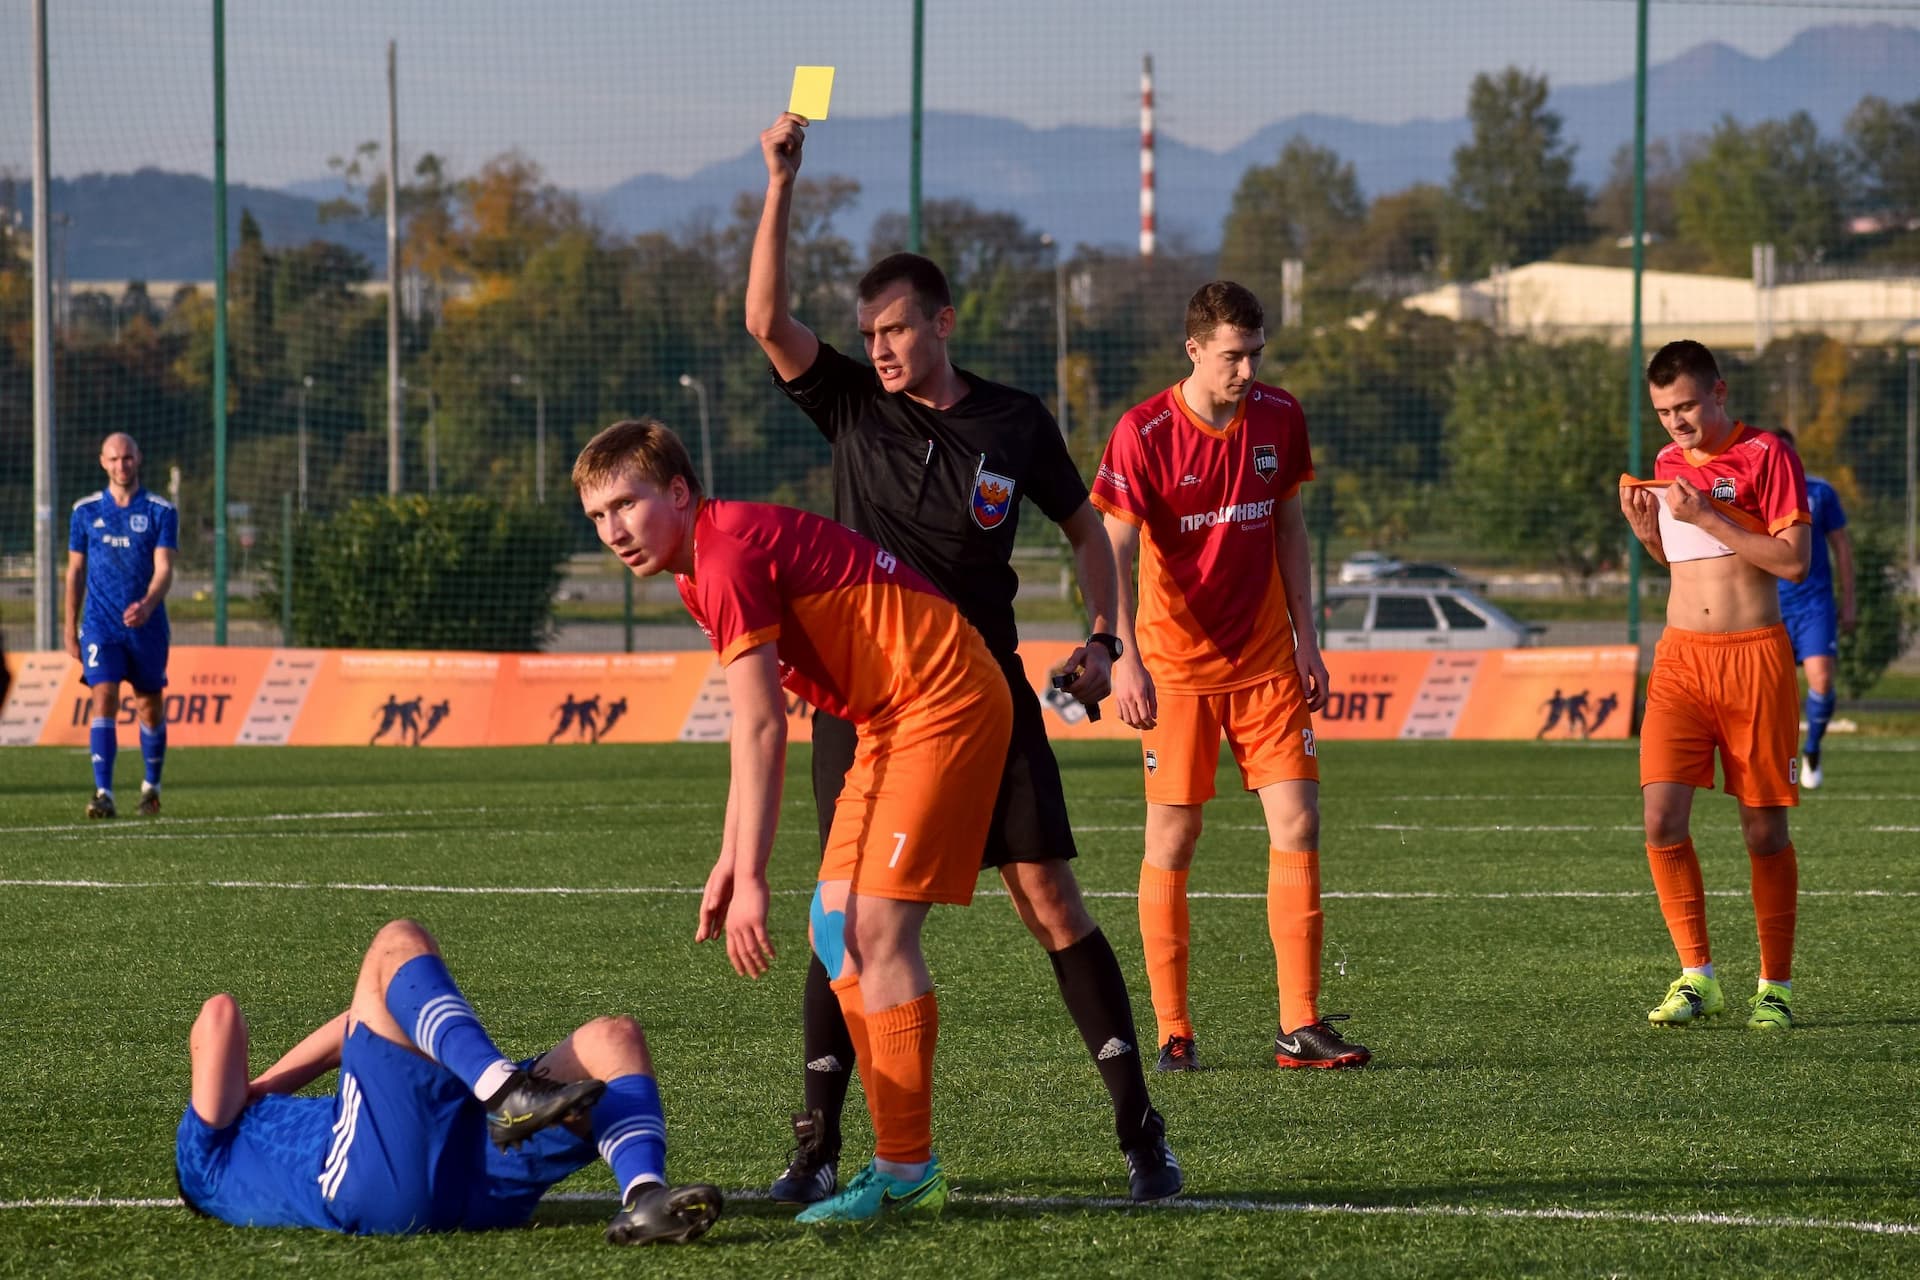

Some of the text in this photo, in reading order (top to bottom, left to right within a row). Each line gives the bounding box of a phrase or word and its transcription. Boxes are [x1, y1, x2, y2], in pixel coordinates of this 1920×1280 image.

[1180, 499, 1275, 534] ПРОДИНВЕСТ
[88, 643, 99, 668] 2
[888, 832, 907, 869] 7
